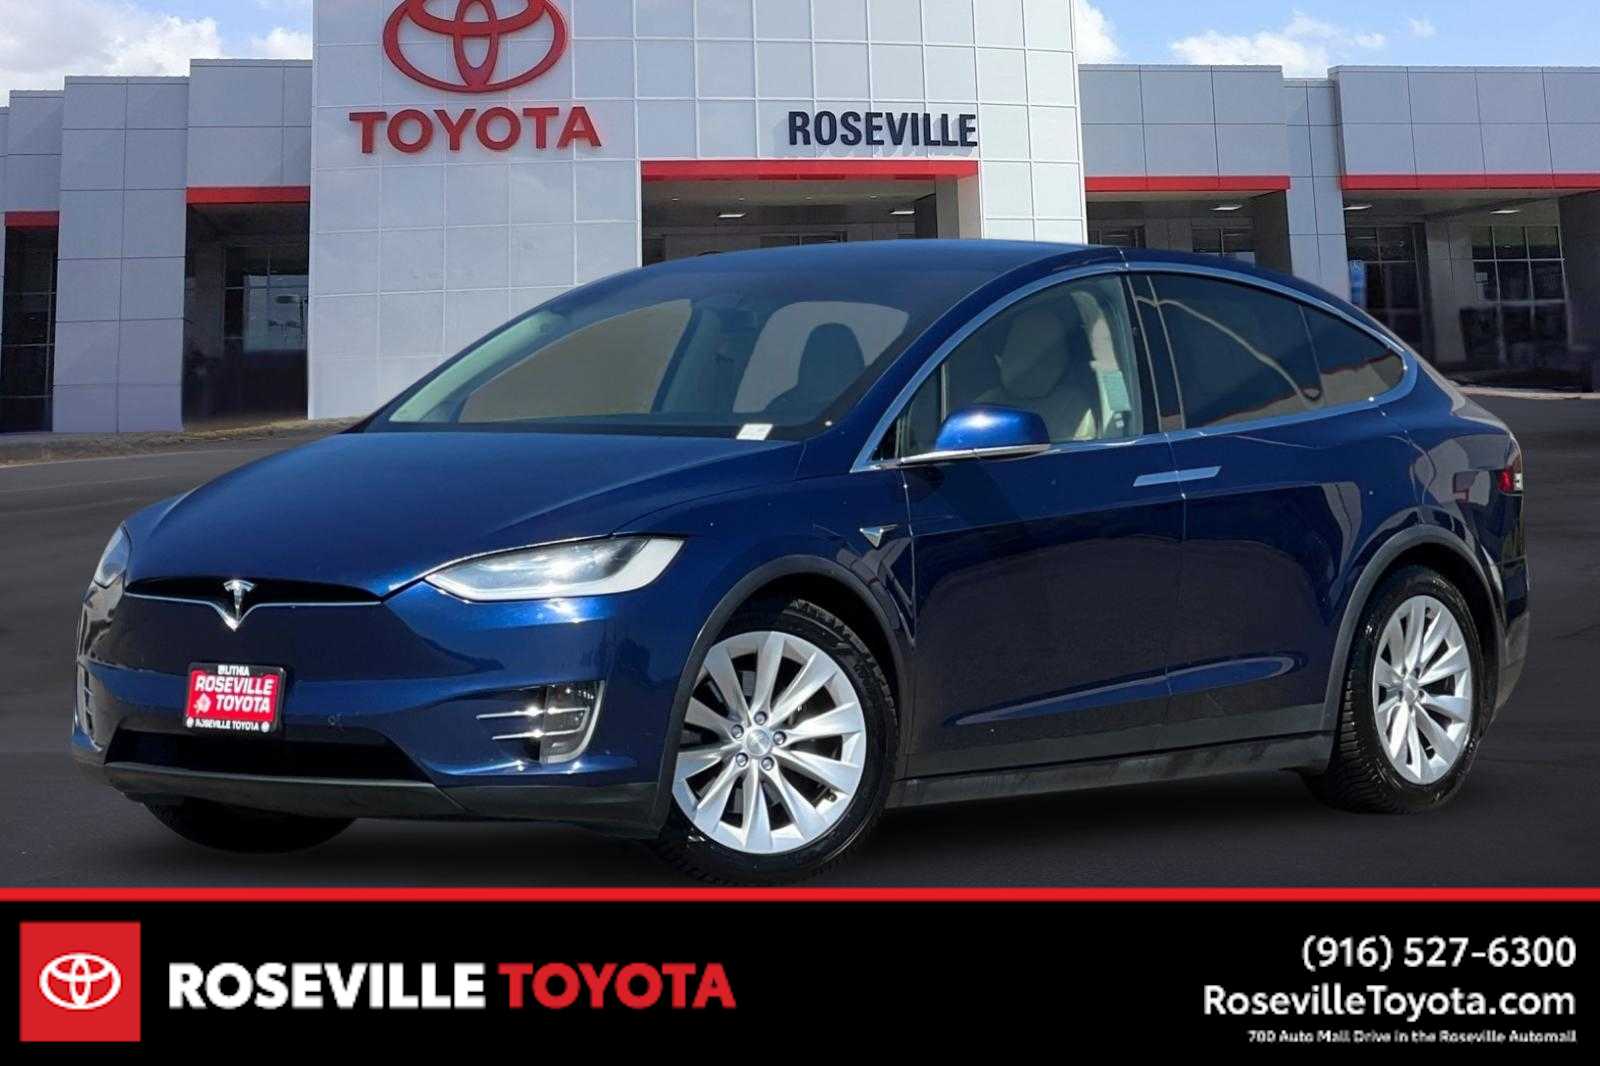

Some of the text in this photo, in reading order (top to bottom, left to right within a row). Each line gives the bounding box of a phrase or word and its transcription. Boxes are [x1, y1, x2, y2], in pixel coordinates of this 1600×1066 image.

[349, 105, 603, 154] TOYOTA
[788, 110, 978, 147] ROSEVILLE
[195, 675, 274, 695] ROSEVILLE
[215, 695, 271, 713] TOYOTA
[231, 720, 260, 731] TOYOTA
